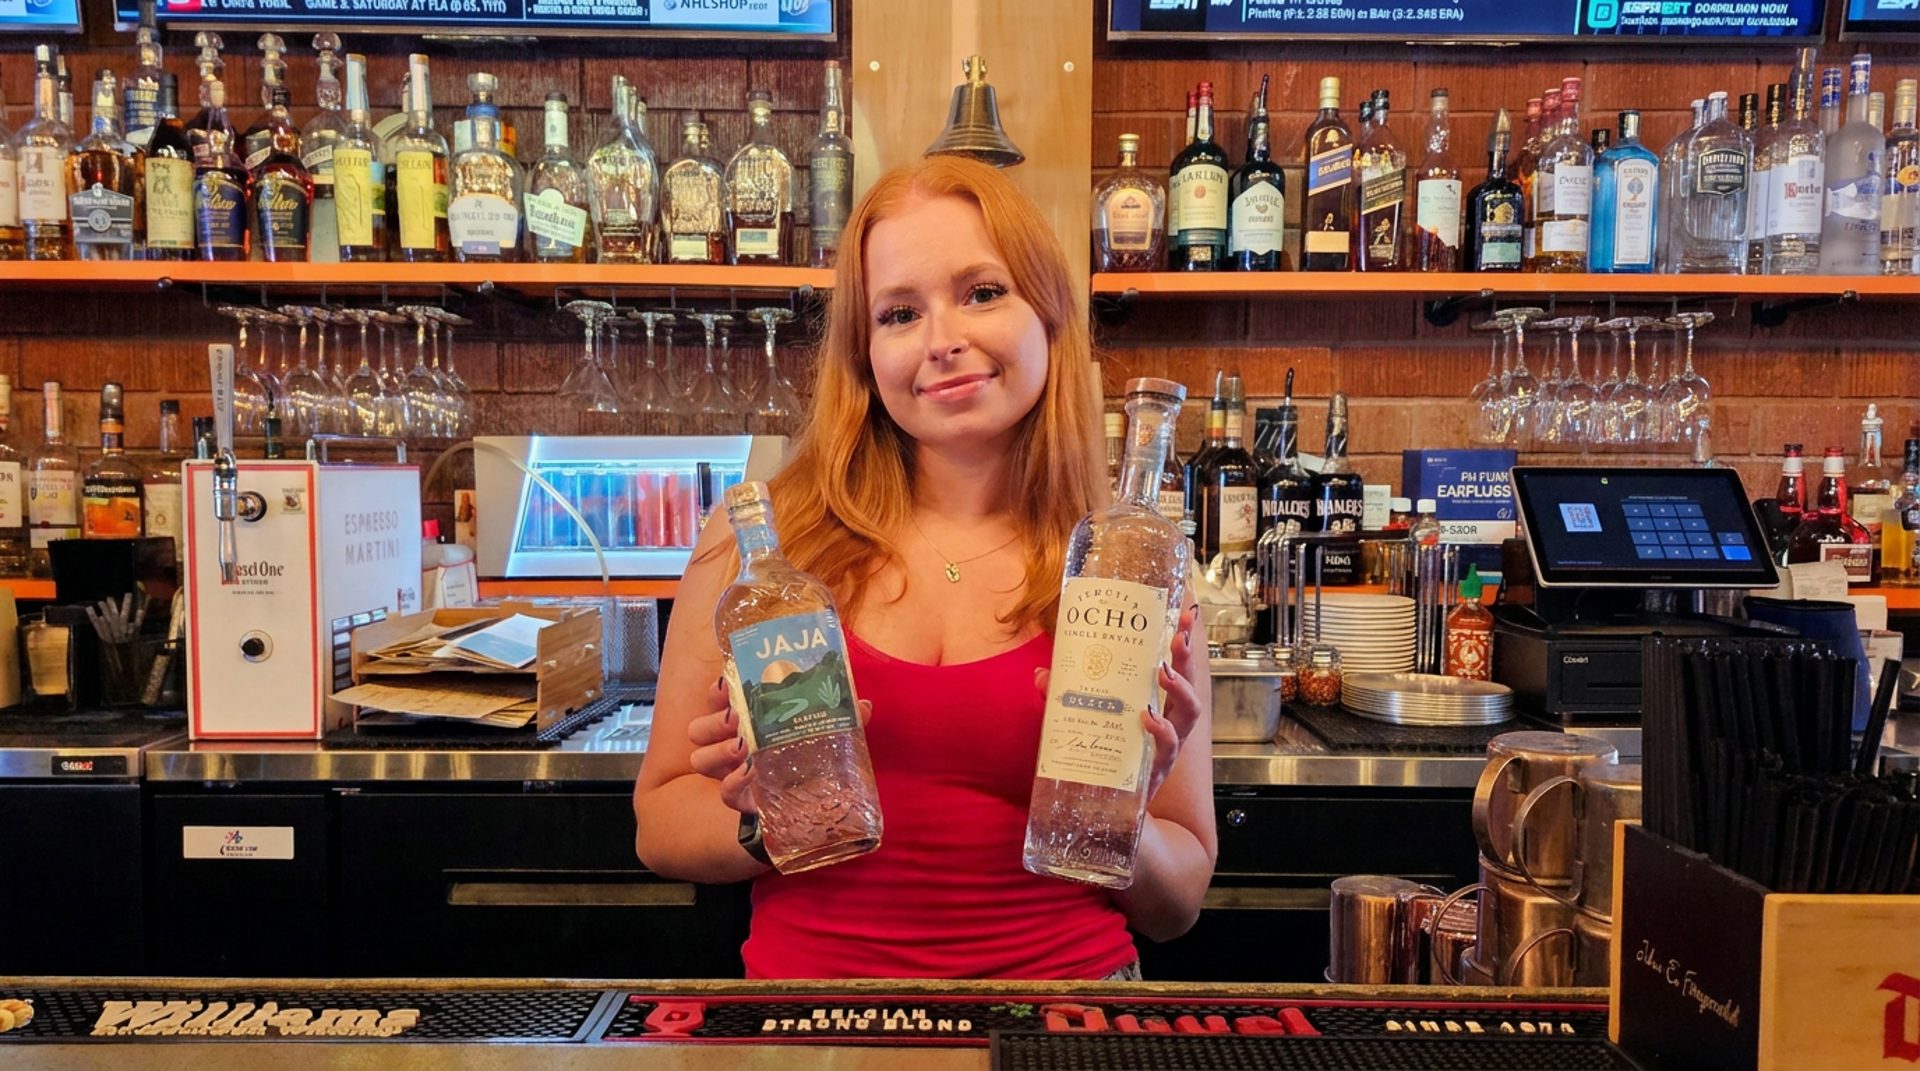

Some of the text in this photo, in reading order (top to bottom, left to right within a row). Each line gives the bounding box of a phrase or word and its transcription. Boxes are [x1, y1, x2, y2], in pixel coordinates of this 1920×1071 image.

[345, 538, 400, 566] MARTINI
[260, 560, 285, 577] One
[1066, 606, 1148, 632] OCHO
[756, 627, 828, 659] JAJA
